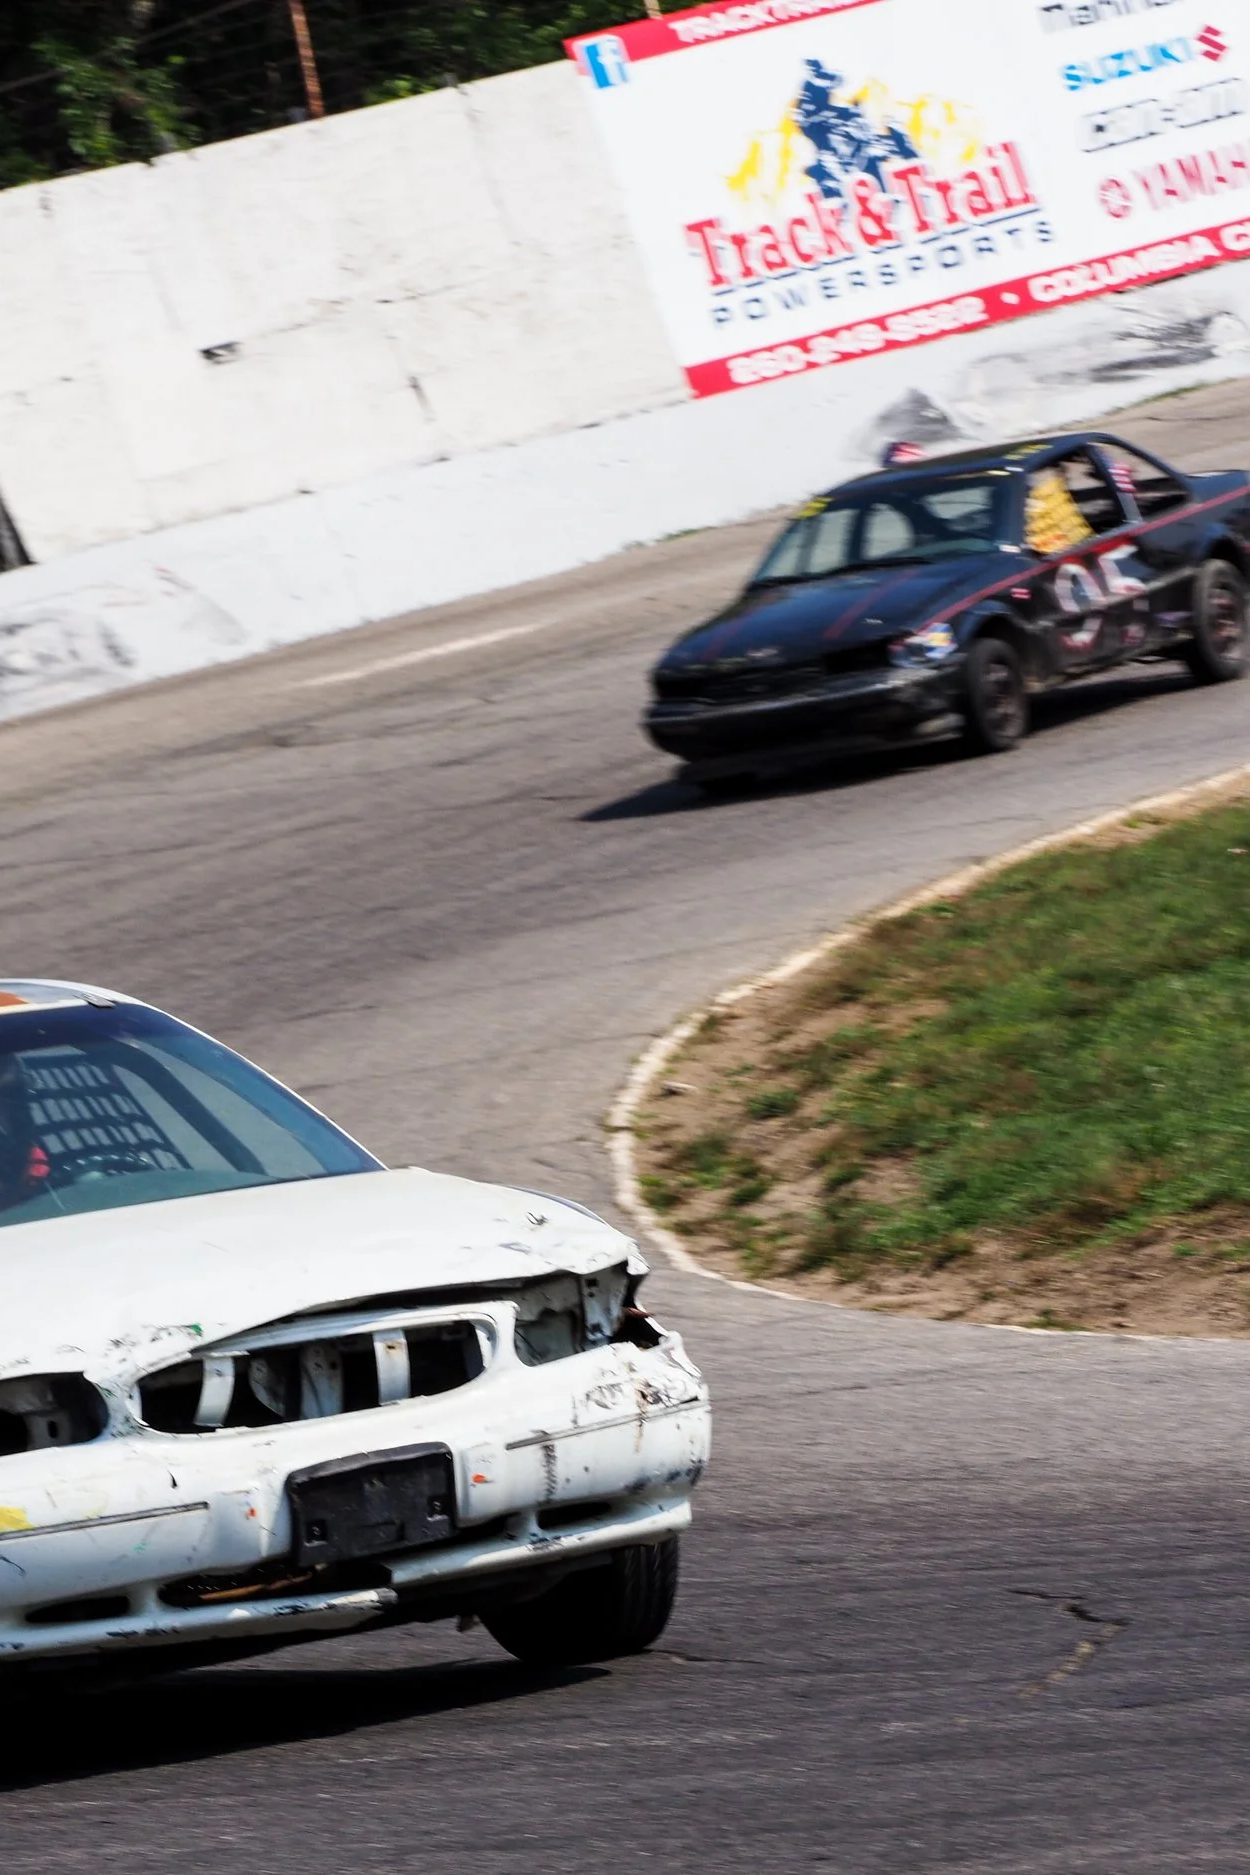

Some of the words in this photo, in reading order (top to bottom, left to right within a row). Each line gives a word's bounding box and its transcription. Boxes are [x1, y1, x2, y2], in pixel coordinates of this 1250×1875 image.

[1062, 37, 1196, 92] SUZUKI
[685, 192, 853, 287] Track
[851, 174, 900, 248] &
[888, 141, 1038, 234] Trail
[711, 219, 1055, 327] POWERSPORTS
[1026, 235, 1222, 303] COLUMBIA
